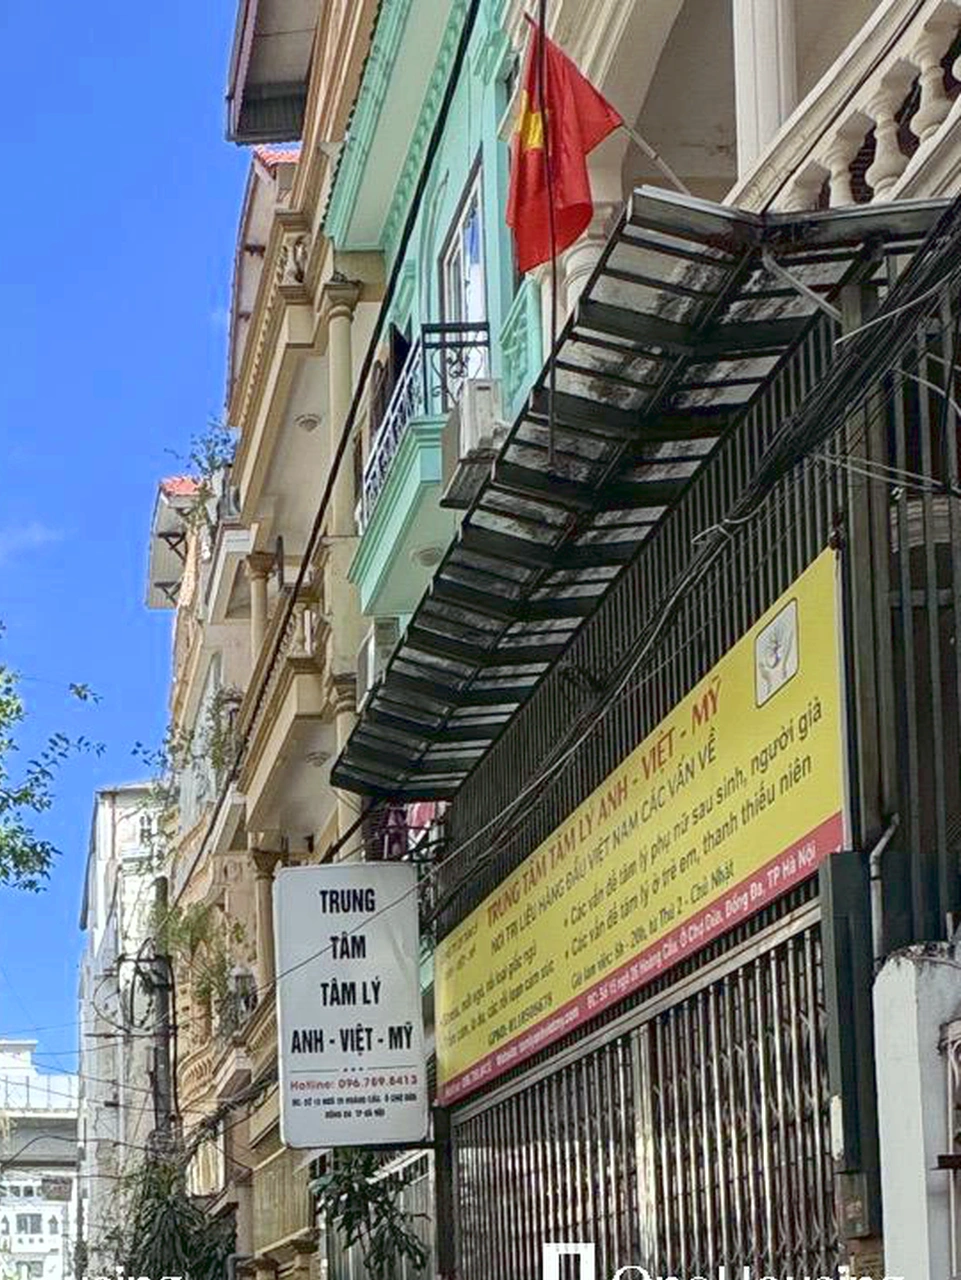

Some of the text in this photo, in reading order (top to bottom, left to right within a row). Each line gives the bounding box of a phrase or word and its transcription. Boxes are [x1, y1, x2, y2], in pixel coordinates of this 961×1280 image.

[487, 877, 519, 929] TRUNG
[522, 851, 546, 896] TÂM
[549, 823, 575, 870] TÂM
[597, 772, 627, 824] ANH
[641, 725, 675, 782] VIỆT
[691, 674, 722, 735] MỸ
[613, 807, 638, 848] NAM
[641, 781, 665, 823] CÁC
[668, 754, 695, 799] VẤN
[698, 725, 716, 772] VỀ
[639, 842, 648, 873] lý
[650, 829, 670, 865] phụ
[692, 795, 712, 824] sau
[716, 761, 747, 804] sinh,
[751, 714, 795, 775] người
[798, 691, 822, 744] già
[679, 847, 699, 873] em,
[702, 807, 737, 855] thanh
[741, 778, 775, 825] thiếu
[780, 754, 811, 795] niên
[767, 863, 779, 889] TP
[782, 850, 797, 879] Hà
[798, 837, 815, 868] Nội
[319, 888, 376, 914] TRUNG
[330, 932, 367, 959] TÂM
[321, 976, 381, 1006] TÂM LÝ
[291, 1029, 324, 1053] ANH
[340, 1023, 372, 1056] VIỆT
[388, 1022, 413, 1050] MỸ
